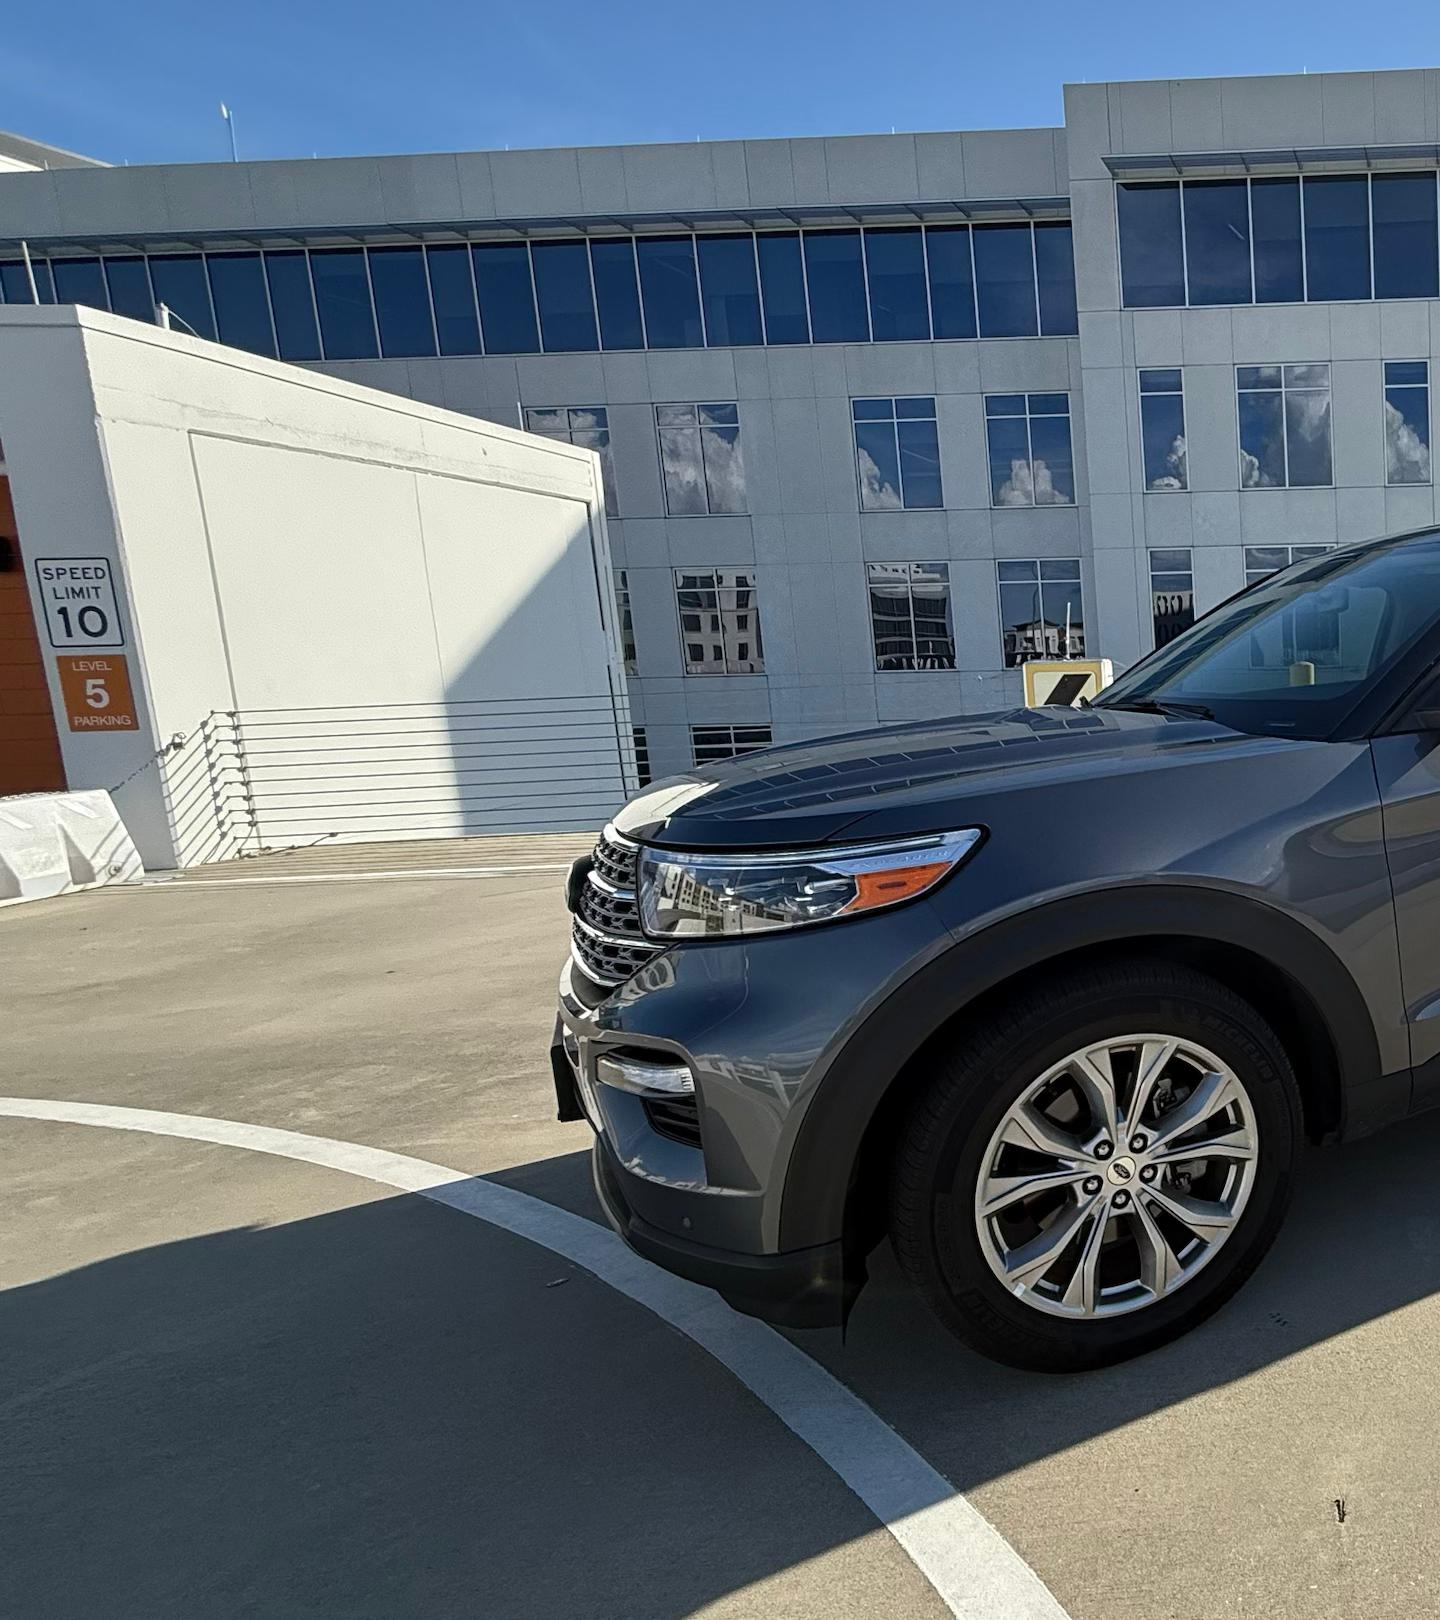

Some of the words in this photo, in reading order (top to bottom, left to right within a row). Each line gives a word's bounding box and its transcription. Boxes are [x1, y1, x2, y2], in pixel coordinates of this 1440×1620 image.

[42, 567, 106, 581] SPEED
[53, 586, 101, 600] LIMIT
[57, 605, 108, 638] 10
[72, 661, 112, 672] LEVEL
[85, 678, 110, 709] 5
[74, 715, 132, 726] PARKING
